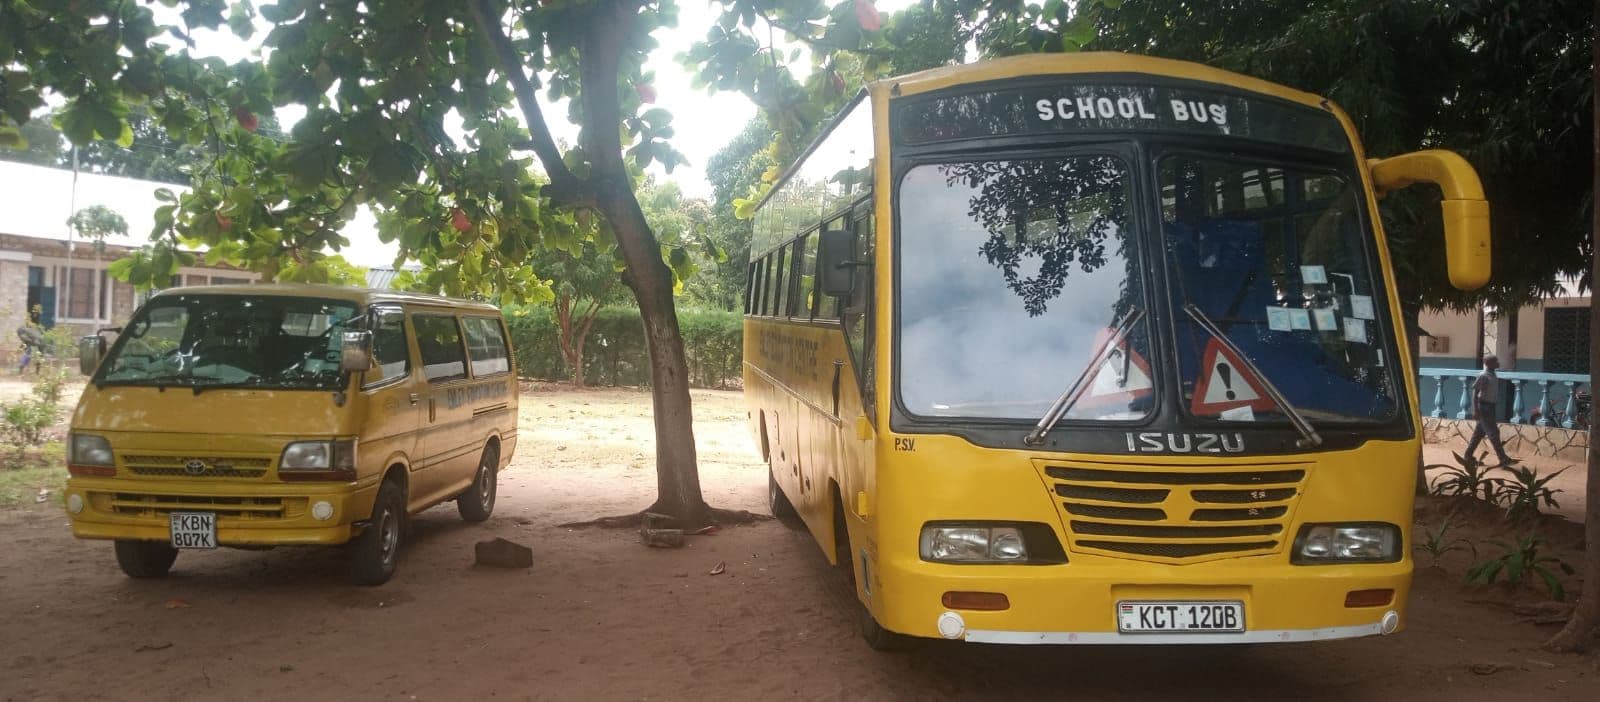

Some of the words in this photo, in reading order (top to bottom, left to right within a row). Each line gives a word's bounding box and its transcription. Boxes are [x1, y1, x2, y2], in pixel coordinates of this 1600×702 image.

[1036, 97, 1155, 120] SCHOOL
[1170, 100, 1226, 125] BUS
[1126, 432, 1245, 453] ISUZU
[181, 515, 210, 531] KBN
[174, 532, 211, 547] 807K
[1140, 606, 1178, 629] KCT
[1188, 606, 1237, 629] 120B
